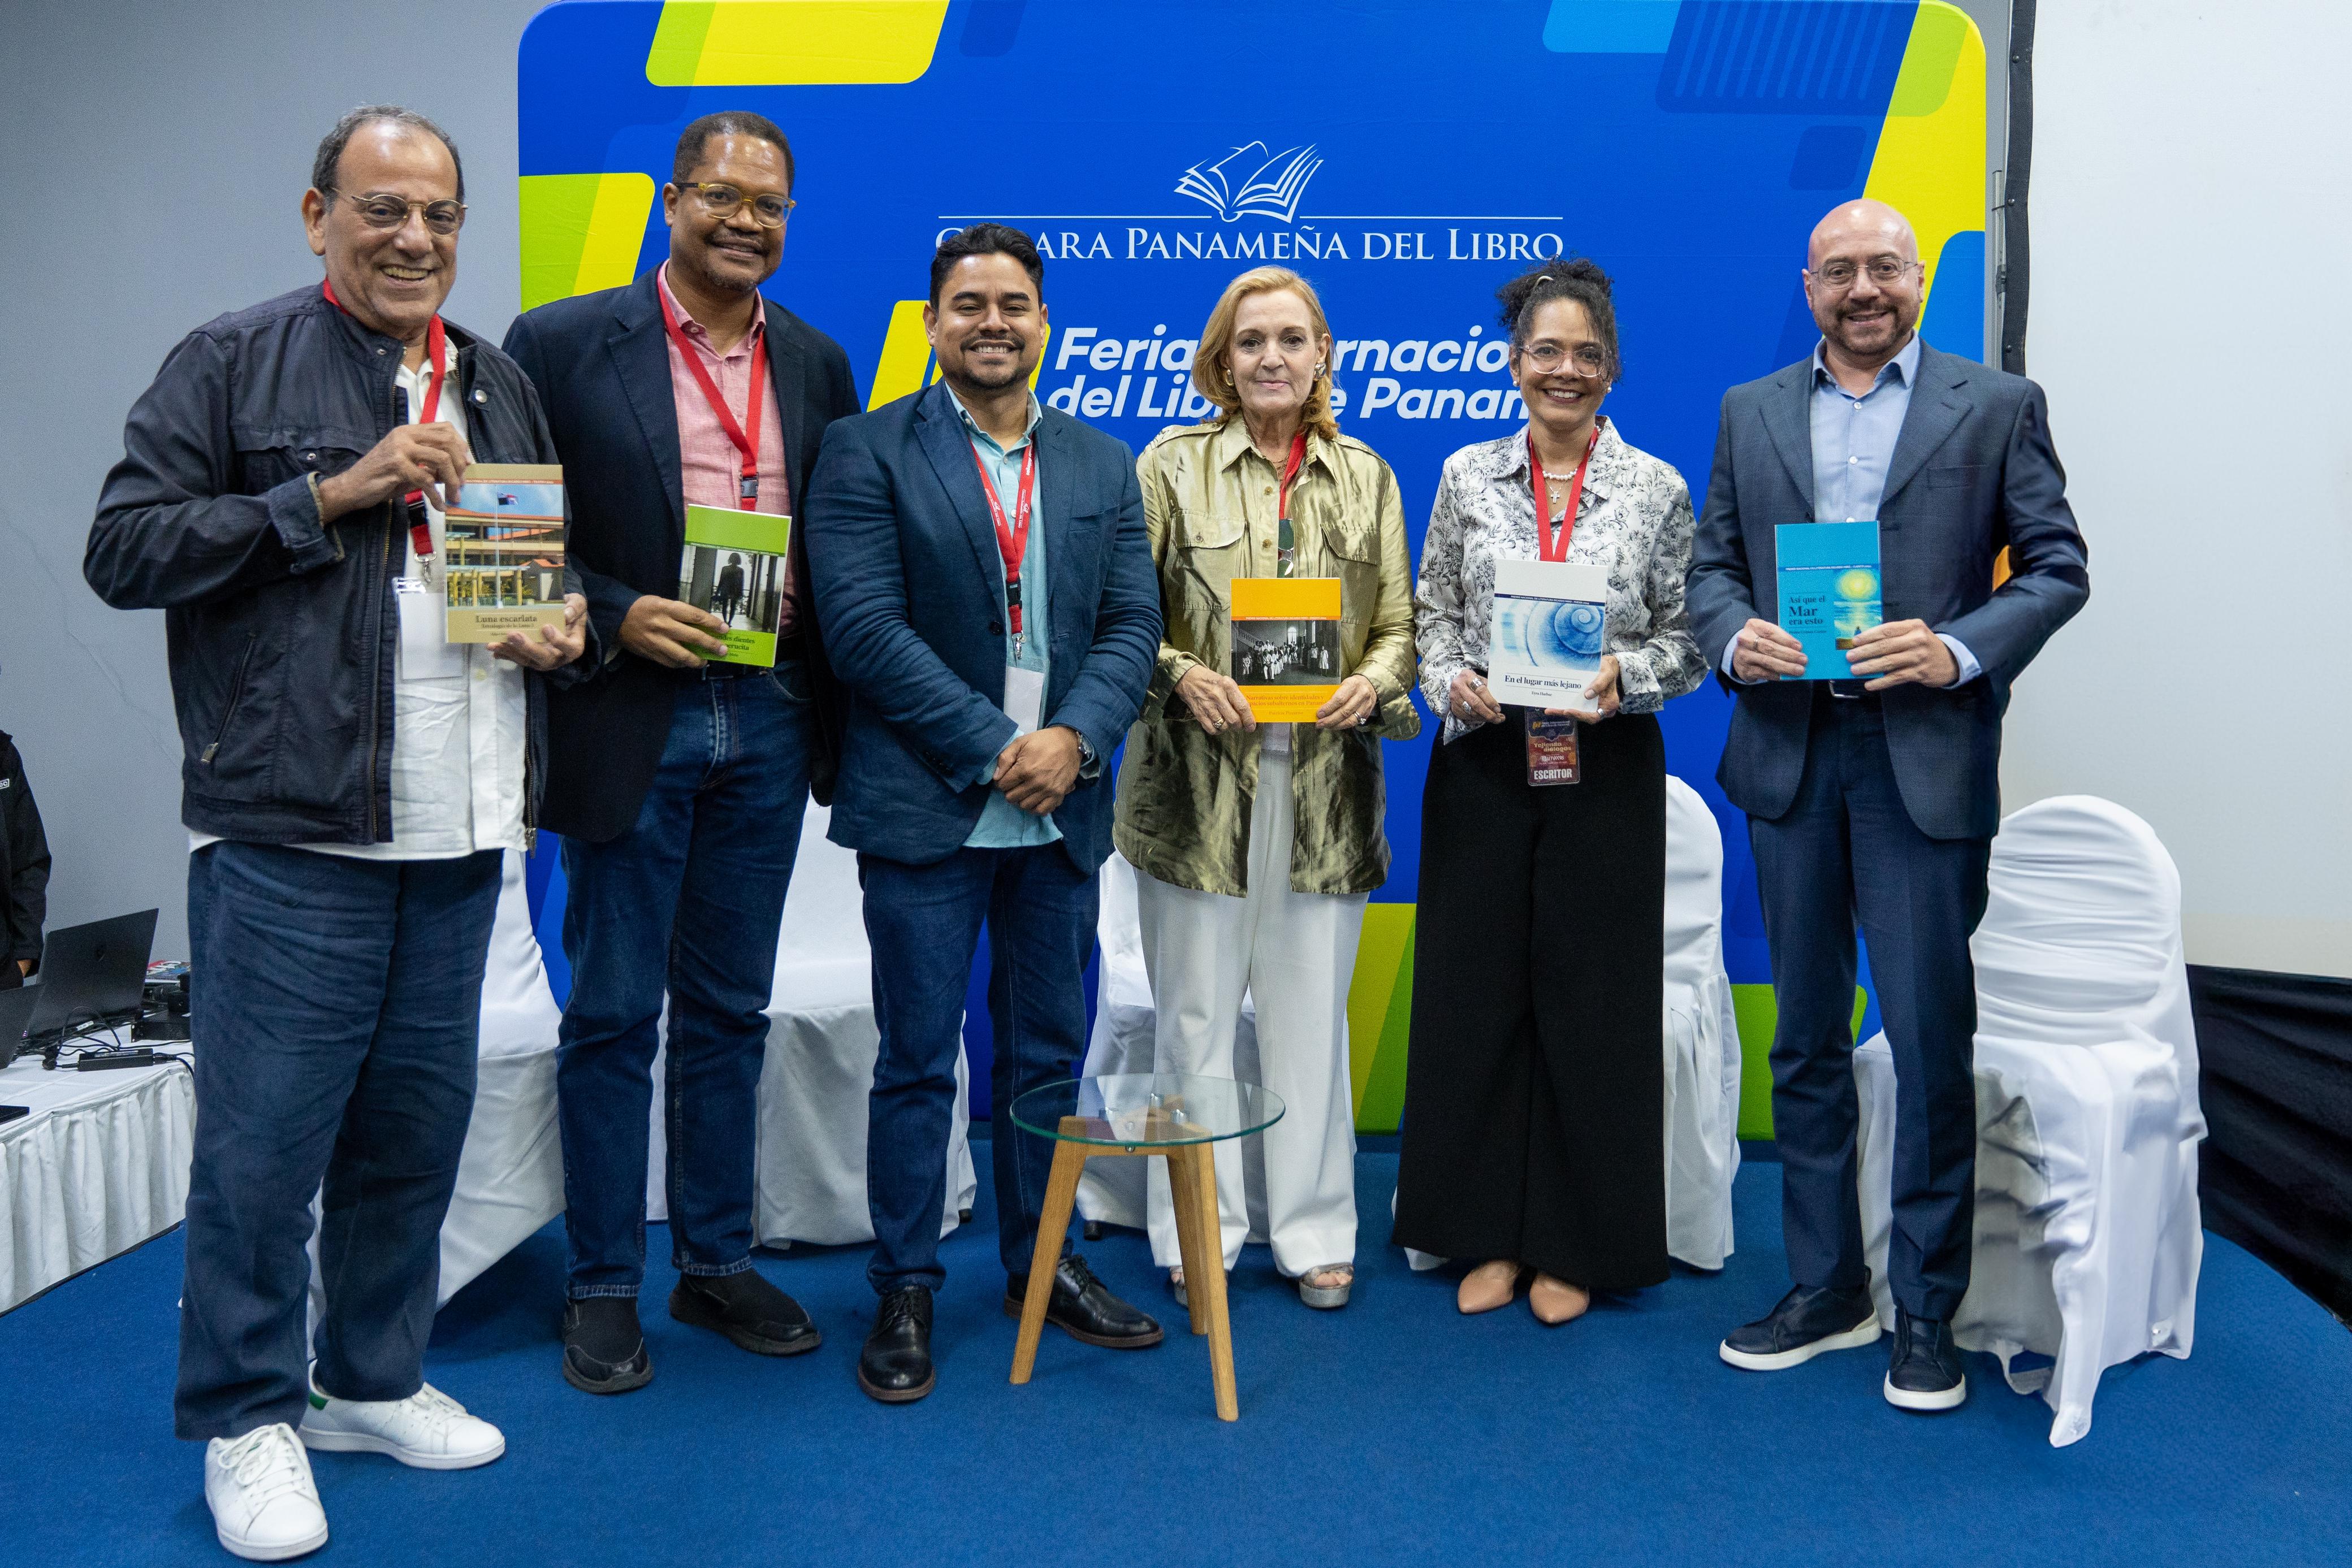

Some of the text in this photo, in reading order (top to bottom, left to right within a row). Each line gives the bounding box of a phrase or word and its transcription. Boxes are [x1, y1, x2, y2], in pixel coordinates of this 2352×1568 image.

[1126, 225, 1351, 259] PANAMEÑA
[1361, 232, 1434, 260] DEL
[1447, 228, 1563, 261] LIBRO
[1055, 323, 1199, 371] Feria
[1047, 375, 1132, 418] del
[1136, 372, 1225, 418] Lib
[1789, 605, 1818, 617] Mar
[1524, 677, 1542, 686] lugar
[1560, 681, 1581, 689] lejano
[1533, 768, 1572, 779] ESCRITOR
